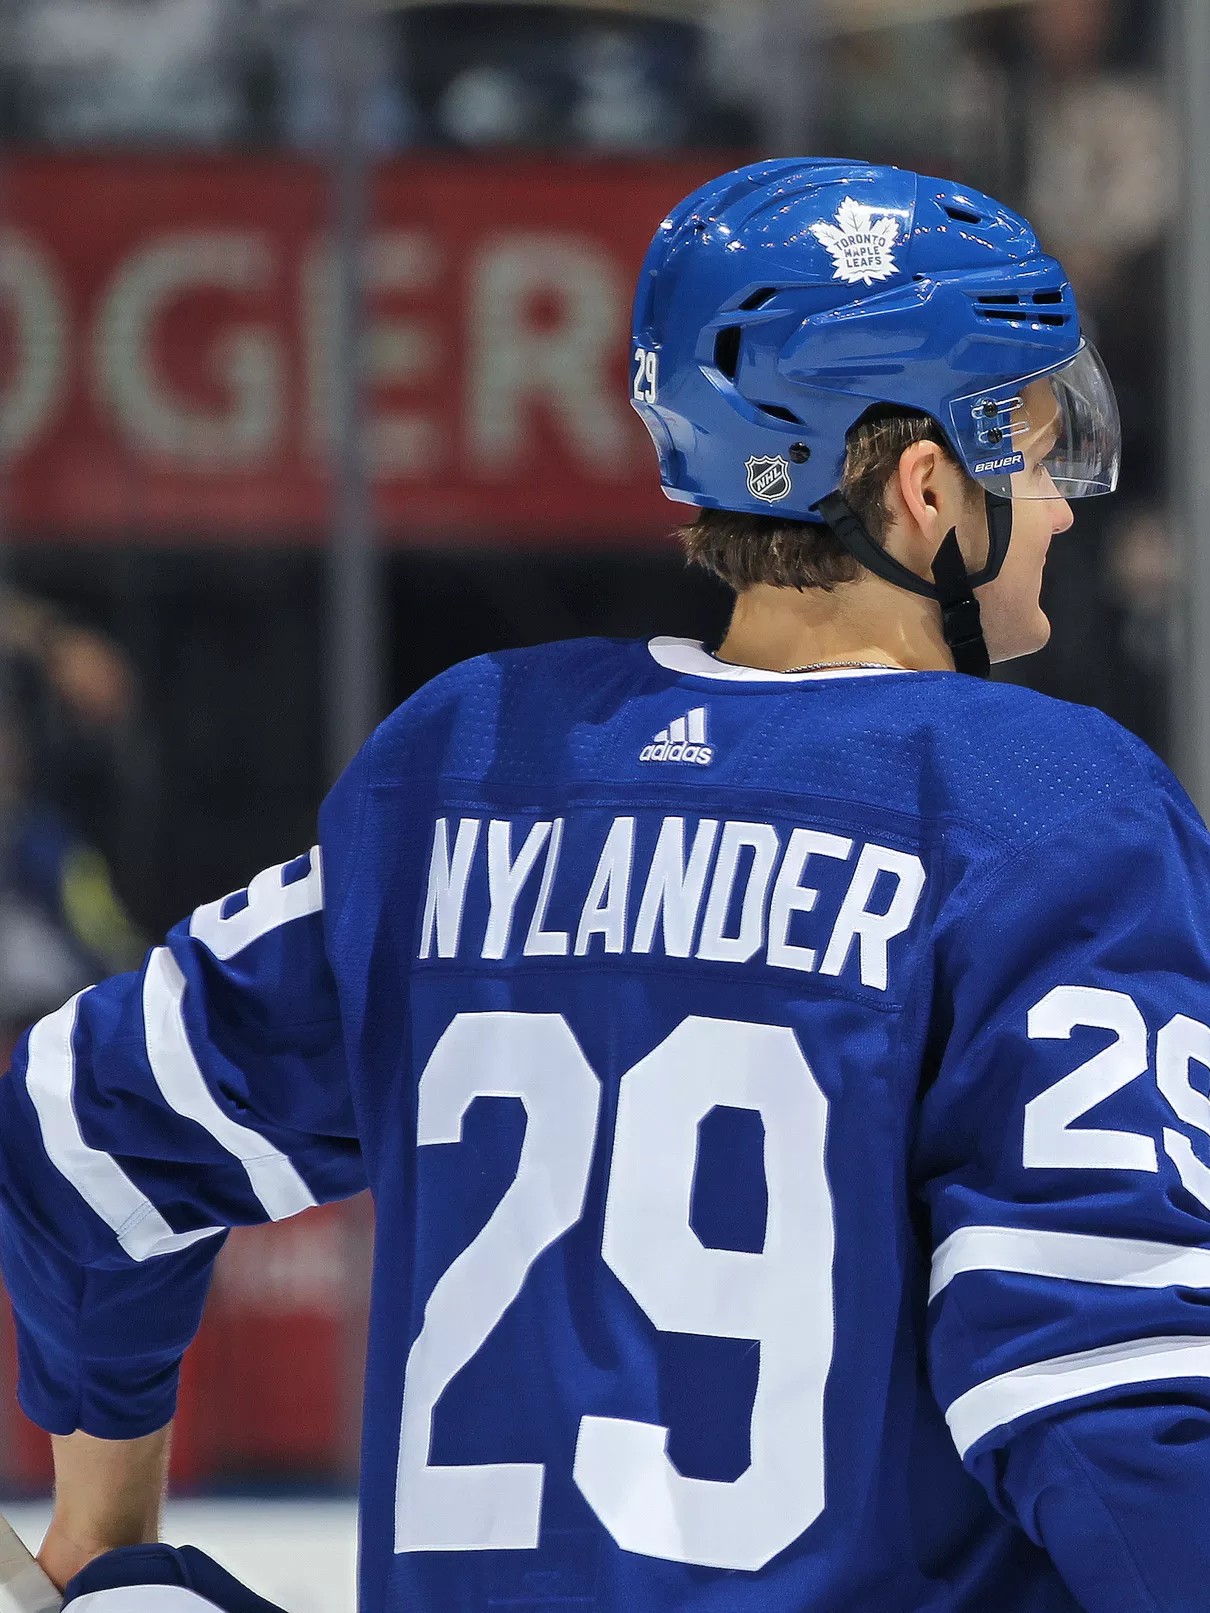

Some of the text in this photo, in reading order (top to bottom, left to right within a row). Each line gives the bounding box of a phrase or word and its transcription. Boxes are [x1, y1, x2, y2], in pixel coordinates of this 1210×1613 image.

[833, 233, 887, 251] TORONTO
[843, 246, 881, 258] MAPLE
[846, 256, 883, 268] LEAFS
[633, 347, 657, 404] 29
[974, 454, 1022, 473] BAUER
[756, 467, 782, 492] NHL
[638, 739, 713, 765] adidas
[419, 816, 926, 991] NYLANDER
[394, 1010, 837, 1574] 29
